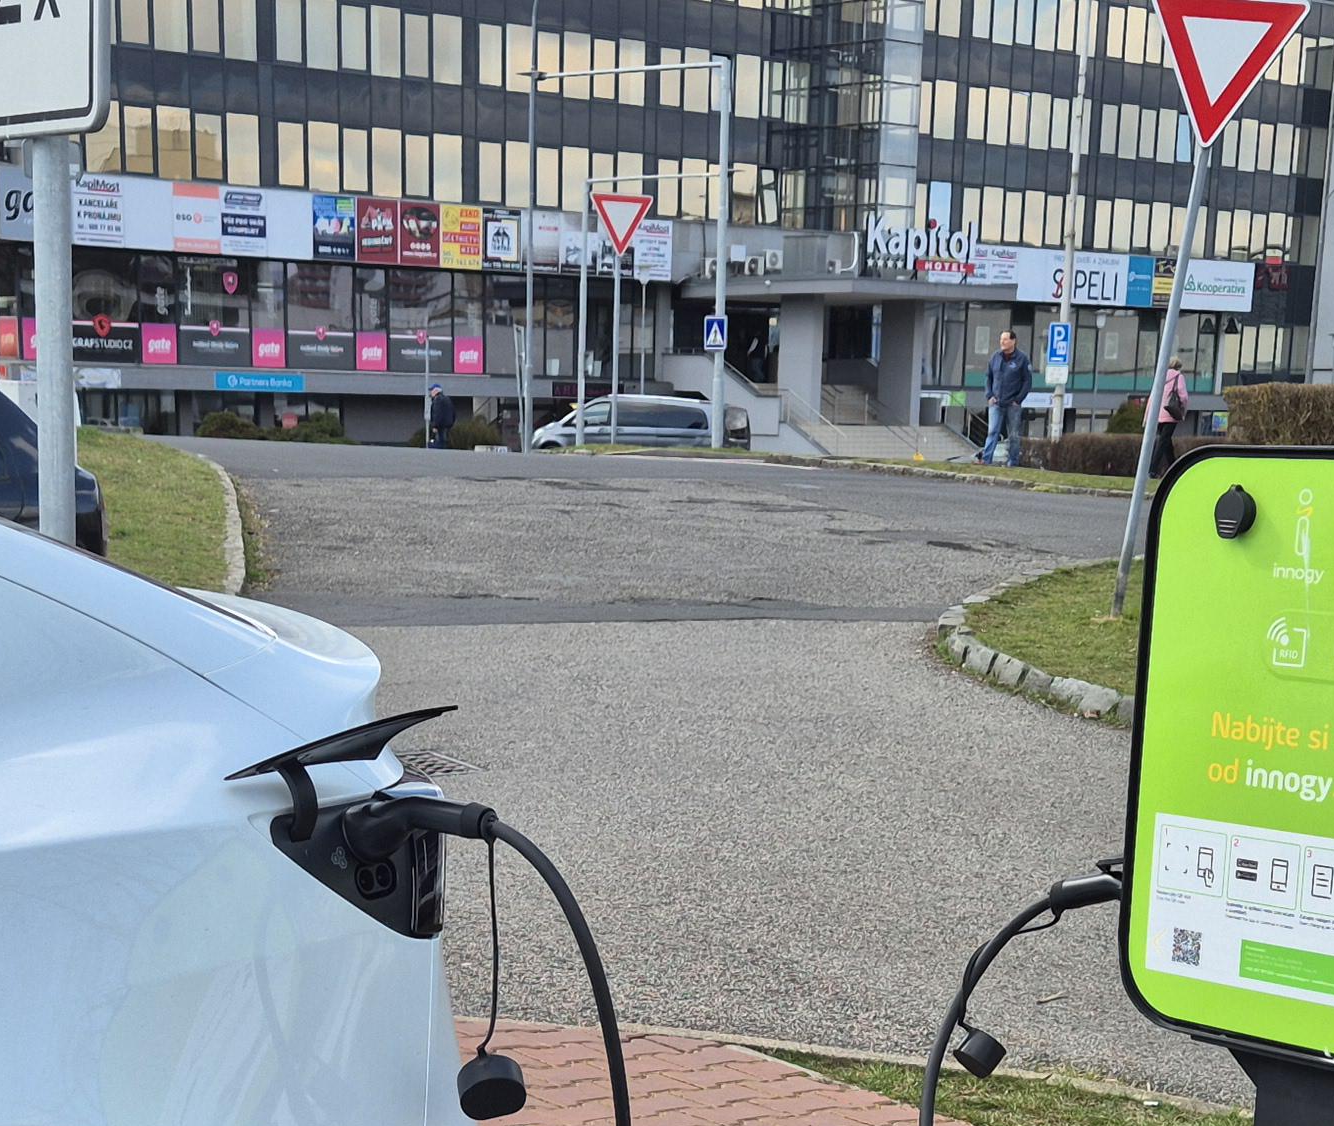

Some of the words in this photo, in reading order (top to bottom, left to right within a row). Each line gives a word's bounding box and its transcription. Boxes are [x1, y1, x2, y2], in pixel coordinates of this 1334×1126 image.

[4, 189, 35, 221] ga
[866, 210, 979, 270] Kapitol
[924, 261, 967, 272] HOTEL
[1052, 268, 1119, 301] SPELI
[1196, 281, 1246, 294] Kooperativa
[1053, 326, 1066, 349] P
[1273, 562, 1325, 585] innogy
[1279, 649, 1299, 660] RFID
[1211, 711, 1301, 751] Nabijte
[1307, 723, 1330, 750] si
[1207, 757, 1240, 784] od
